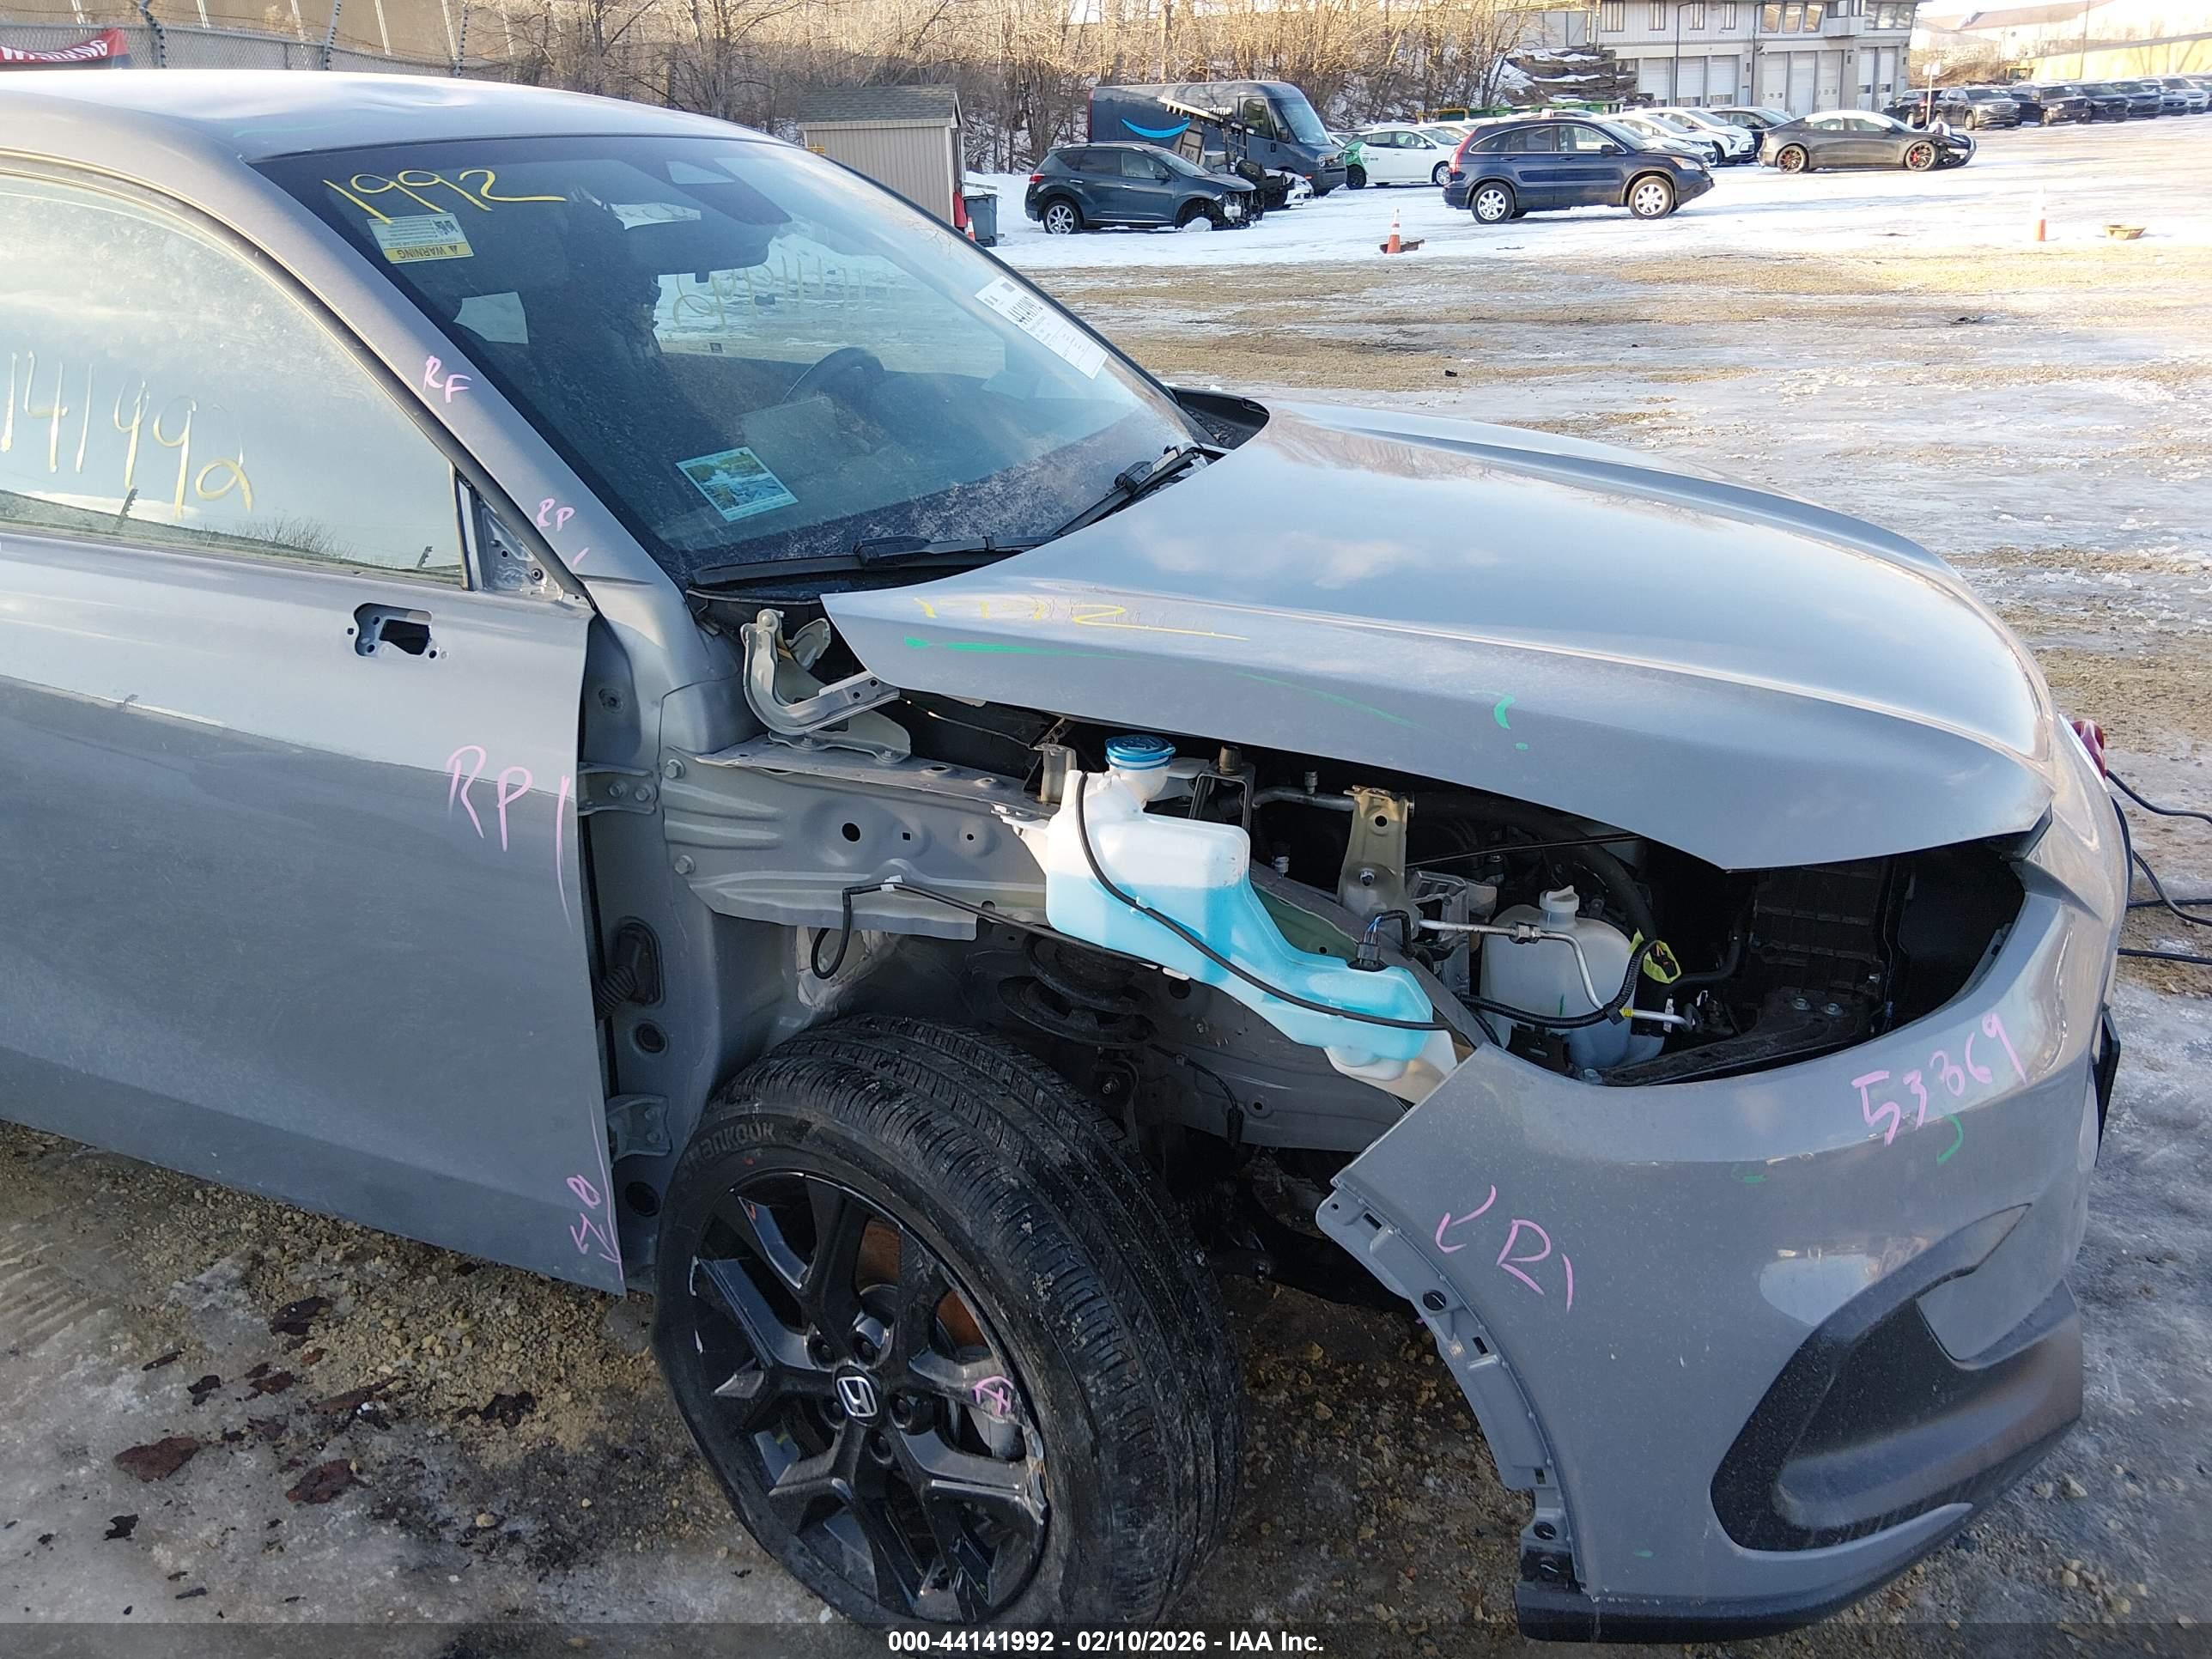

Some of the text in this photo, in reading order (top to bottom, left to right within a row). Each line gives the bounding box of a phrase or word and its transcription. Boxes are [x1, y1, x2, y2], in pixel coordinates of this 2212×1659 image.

[322, 169, 567, 225] 1992
[397, 246, 447, 259] WARNING
[422, 355, 472, 404] RF
